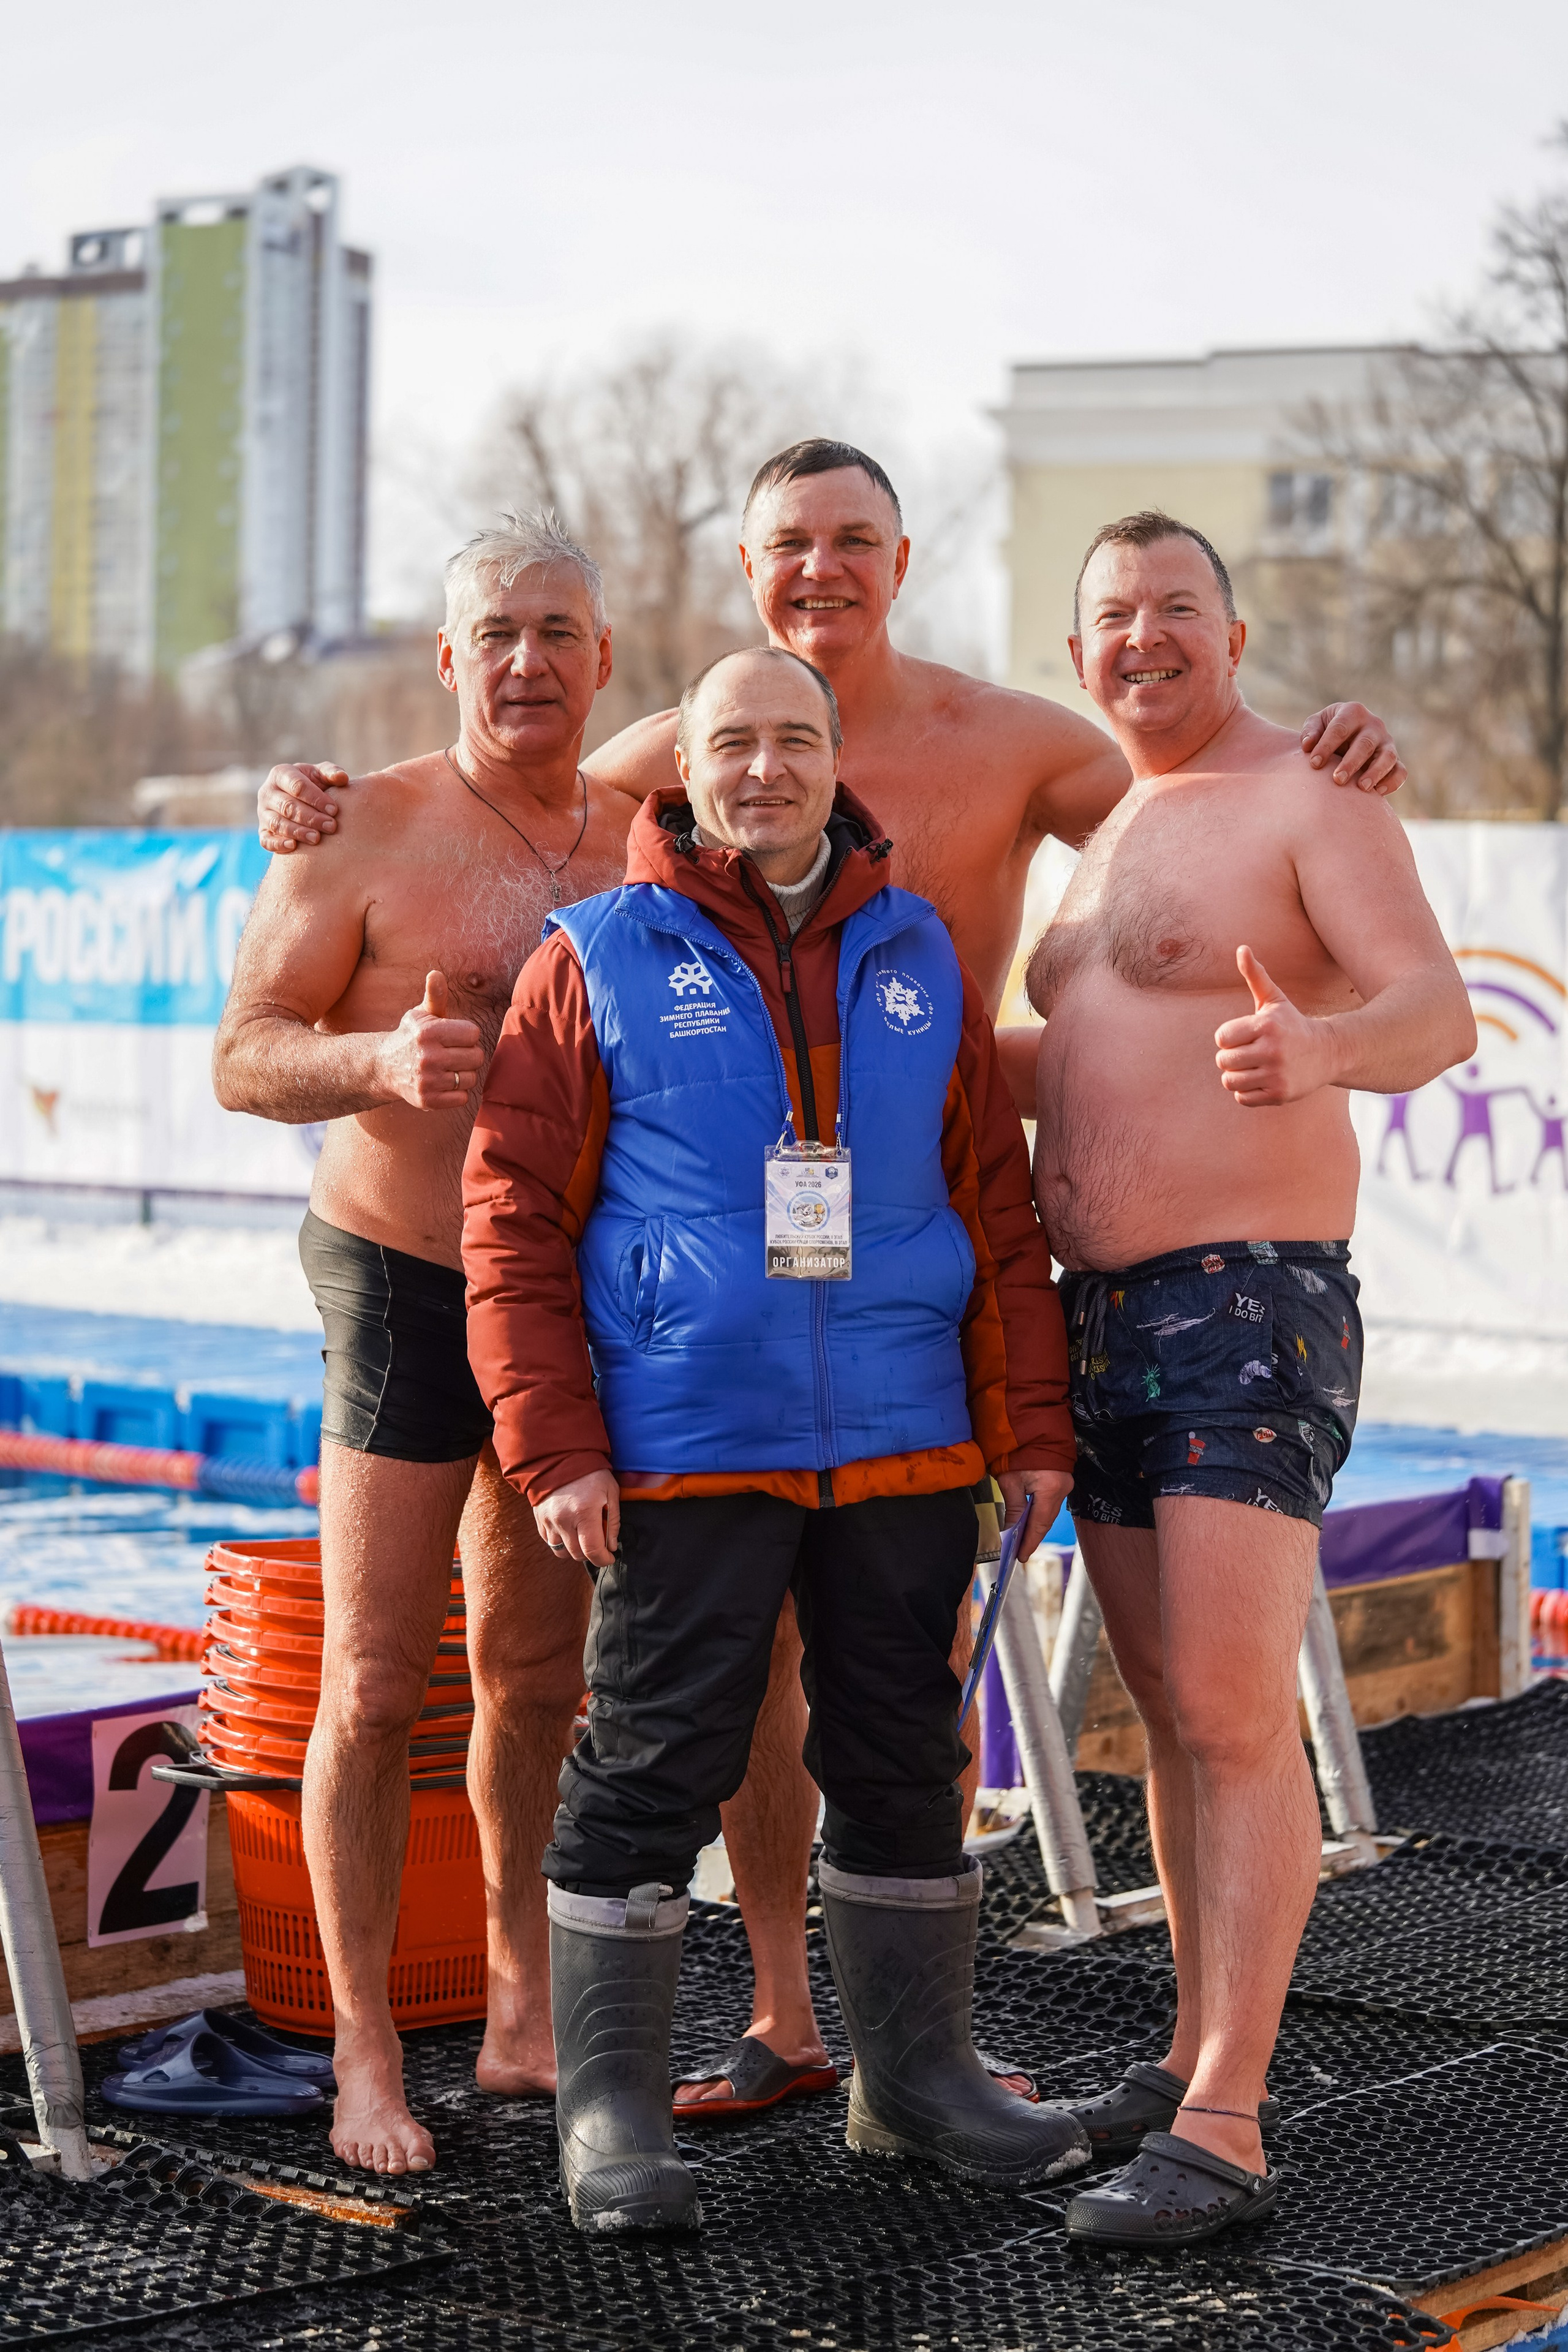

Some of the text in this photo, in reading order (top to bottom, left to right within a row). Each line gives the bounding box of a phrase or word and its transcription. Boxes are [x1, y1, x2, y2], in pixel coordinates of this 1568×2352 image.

[674, 1002, 716, 1011] ФЕДЕРАЦИЯ
[660, 1007, 731, 1022] ЗИМНЕГО ПЛАВАНИЯ
[674, 1018, 720, 1028] РЕСПУБЛИКИ
[908, 1020, 931, 1035] КУНИЦЫ
[669, 1026, 726, 1038] БАШКОРТОСТАН
[772, 1256, 845, 1268] ОРГАНИЗАТОР
[1229, 1305, 1264, 1323] I DO BIT
[99, 1721, 201, 1935] 2
